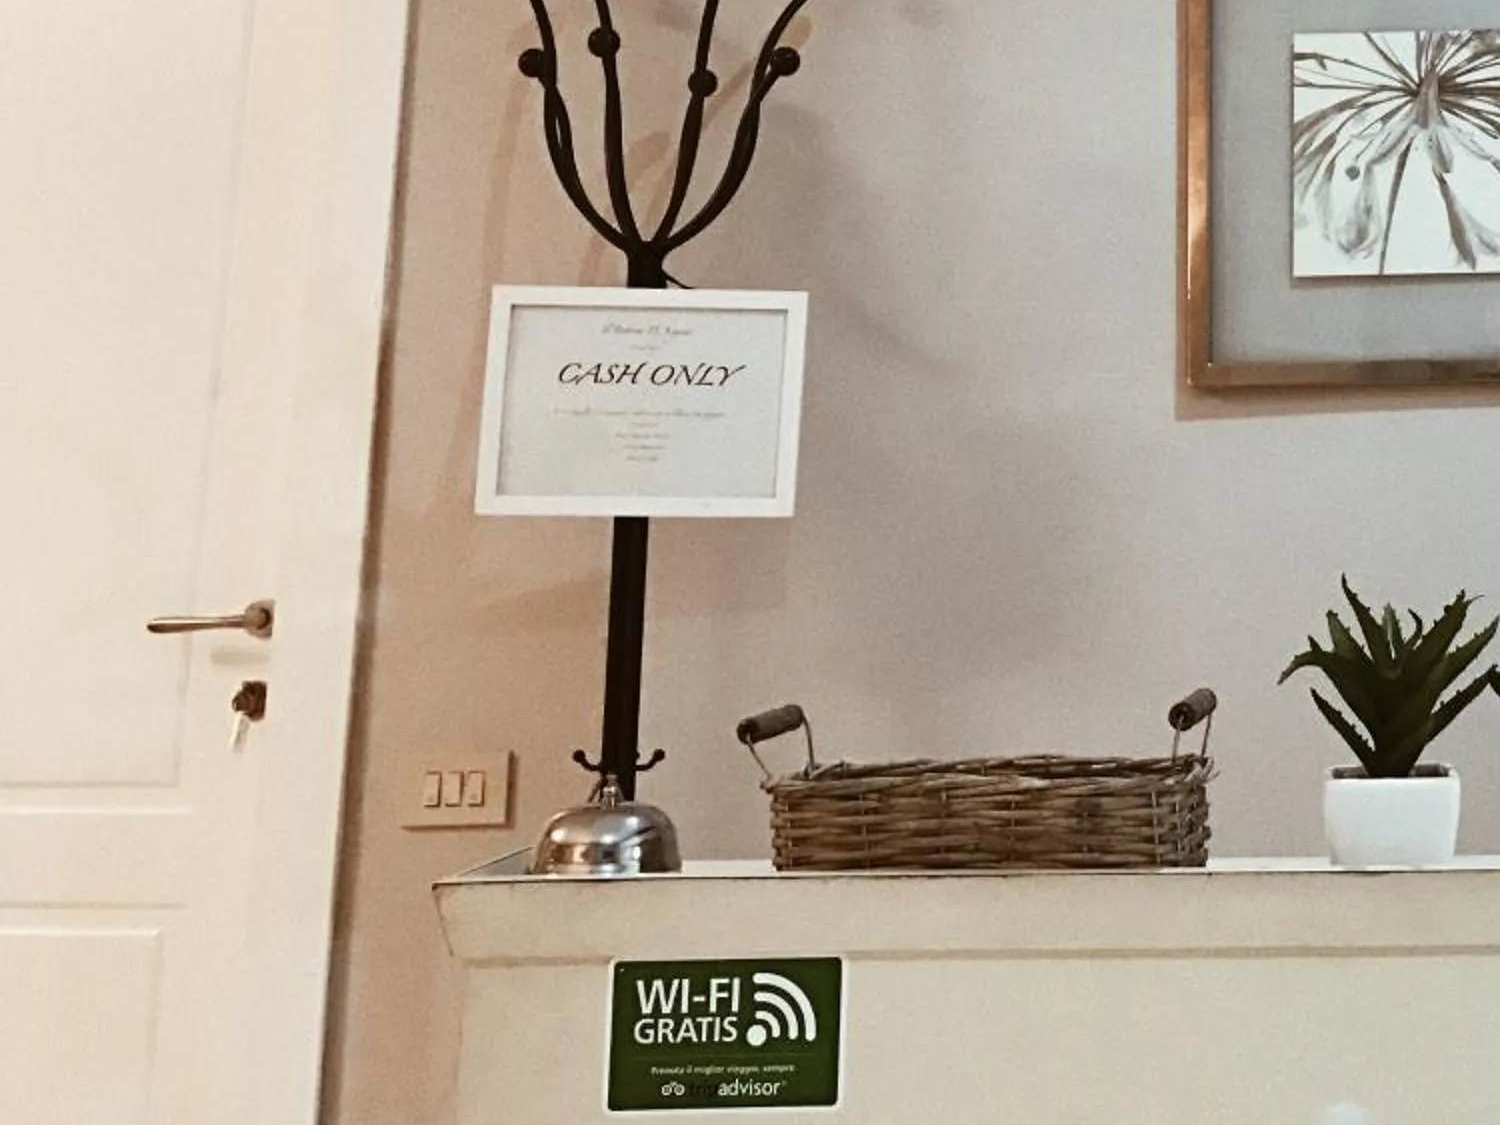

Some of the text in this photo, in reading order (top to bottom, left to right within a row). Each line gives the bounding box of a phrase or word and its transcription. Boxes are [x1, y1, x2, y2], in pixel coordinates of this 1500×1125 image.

[558, 361, 747, 386] CASH ONLY
[635, 976, 741, 1014] WI-FI
[633, 1016, 738, 1044] GRATIS
